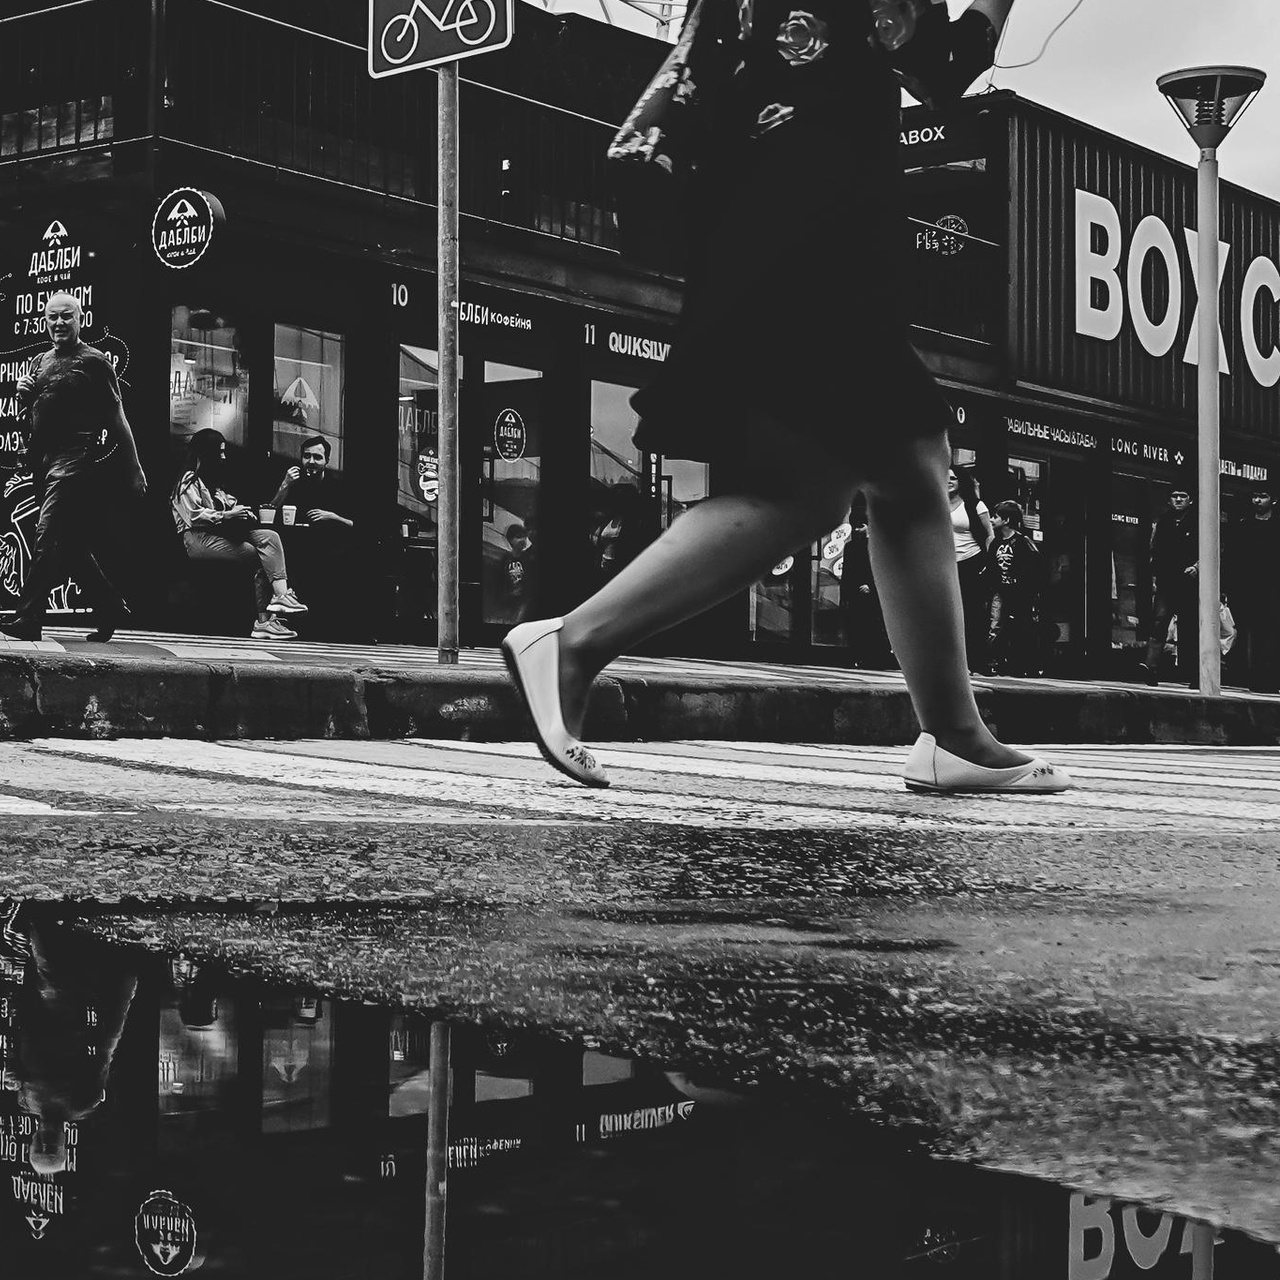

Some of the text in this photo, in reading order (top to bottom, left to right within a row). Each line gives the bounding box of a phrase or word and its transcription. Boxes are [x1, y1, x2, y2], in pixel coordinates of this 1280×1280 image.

[158, 224, 206, 251] ДАБЛБИ
[28, 245, 81, 277] ДАБЛБИ
[16, 293, 33, 315] ПО
[391, 283, 408, 308] 10
[23, 316, 47, 335] 7:30
[459, 302, 532, 330] БЛБИ КОФЕЙНЯ
[584, 323, 596, 345] 11
[399, 405, 438, 435] ДАБЛБ
[1006, 417, 1050, 440] АВИЛЬНЫЕ
[1111, 437, 1169, 463] LONG RIVER
[1111, 513, 1139, 525] LONG RIVER
